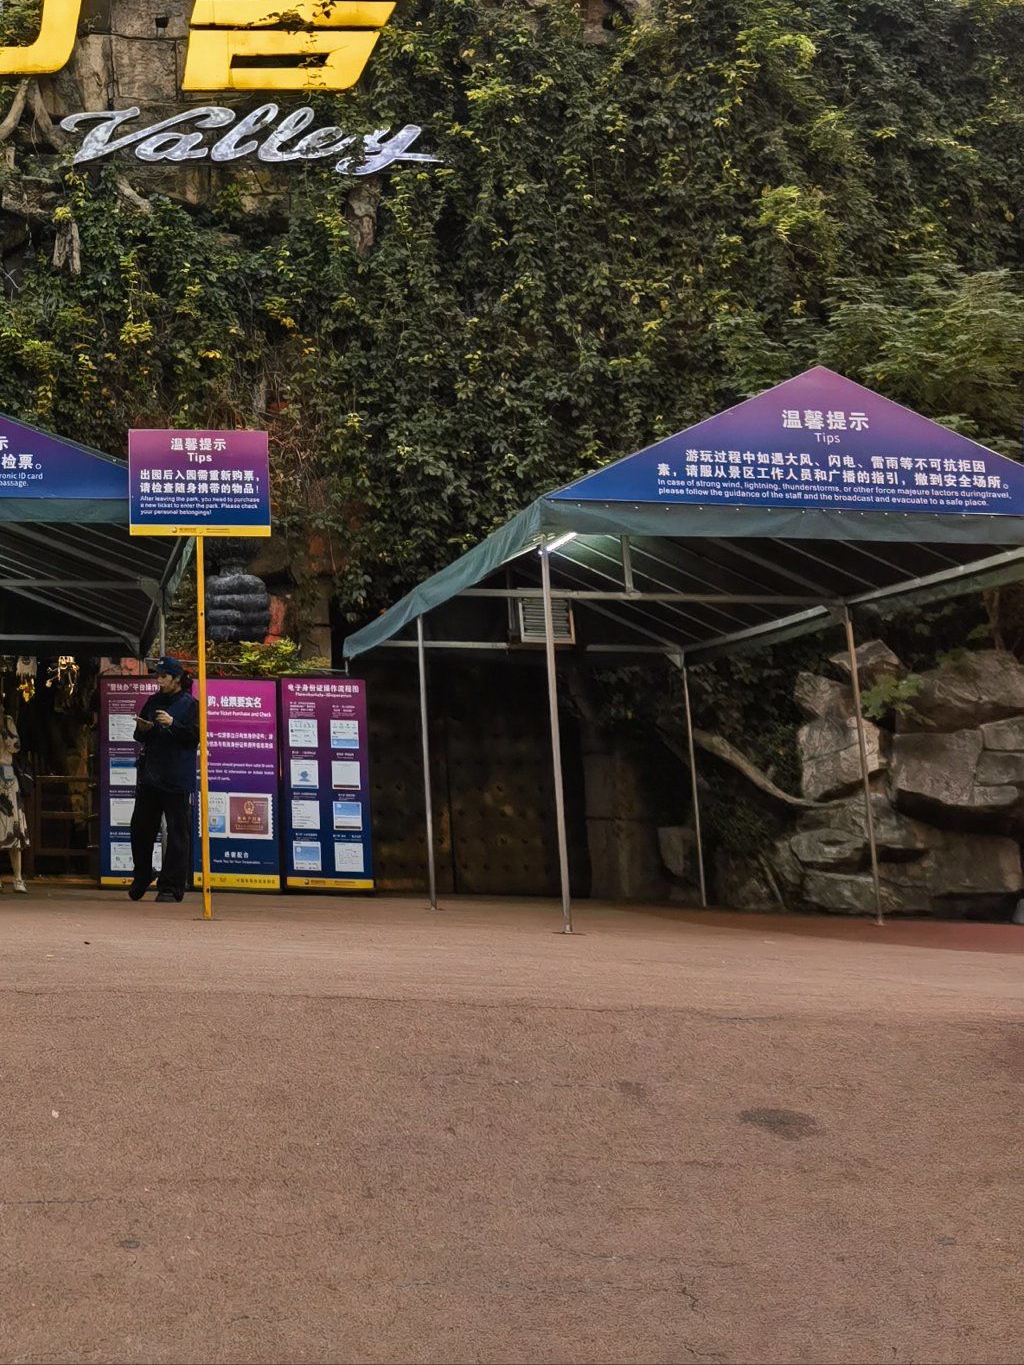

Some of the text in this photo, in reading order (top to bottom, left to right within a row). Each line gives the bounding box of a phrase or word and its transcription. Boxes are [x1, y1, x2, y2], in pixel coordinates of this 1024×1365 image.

[59, 102, 446, 175] Valley
[782, 409, 869, 431] 温馨提示
[170, 438, 227, 451] 温馨提示
[815, 433, 841, 446] Tips
[187, 453, 212, 463] Tips
[685, 449, 986, 474] 游玩过程中如遇大风、闪电、雷雨等不可抗拒因
[659, 487, 684, 496] please
[724, 489, 760, 499] guidance
[892, 496, 928, 504] evacuate
[965, 499, 989, 508] place.
[696, 480, 720, 489] strong
[897, 489, 931, 498] majeure
